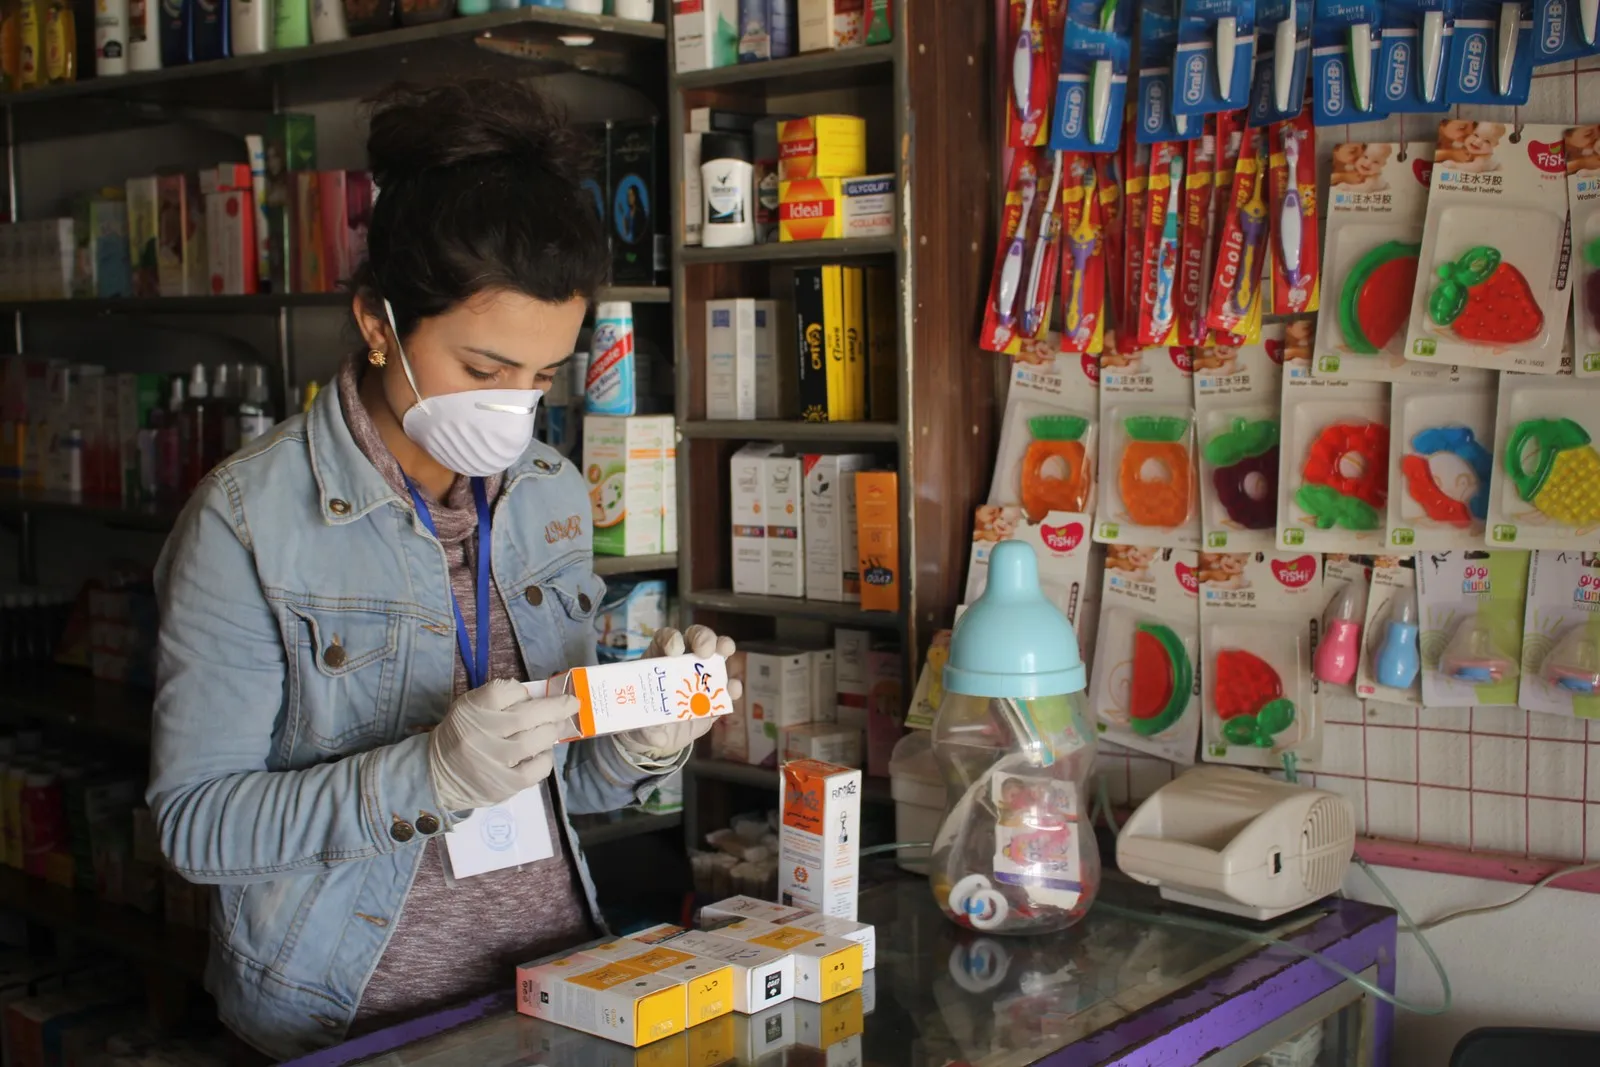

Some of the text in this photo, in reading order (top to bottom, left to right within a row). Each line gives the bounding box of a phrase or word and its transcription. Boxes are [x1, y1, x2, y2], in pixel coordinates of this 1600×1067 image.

[1546, 3, 1562, 49] Oral-B
[1389, 48, 1406, 95] Oral-B
[1464, 38, 1482, 88] Oral-B
[1327, 64, 1341, 111] Oral-B
[789, 202, 823, 219] Ideal
[1184, 248, 1201, 306] Caola
[1218, 230, 1244, 288] Caola
[1462, 580, 1491, 592] Nunu
[614, 687, 627, 705] 50
[626, 684, 637, 705] SPF
